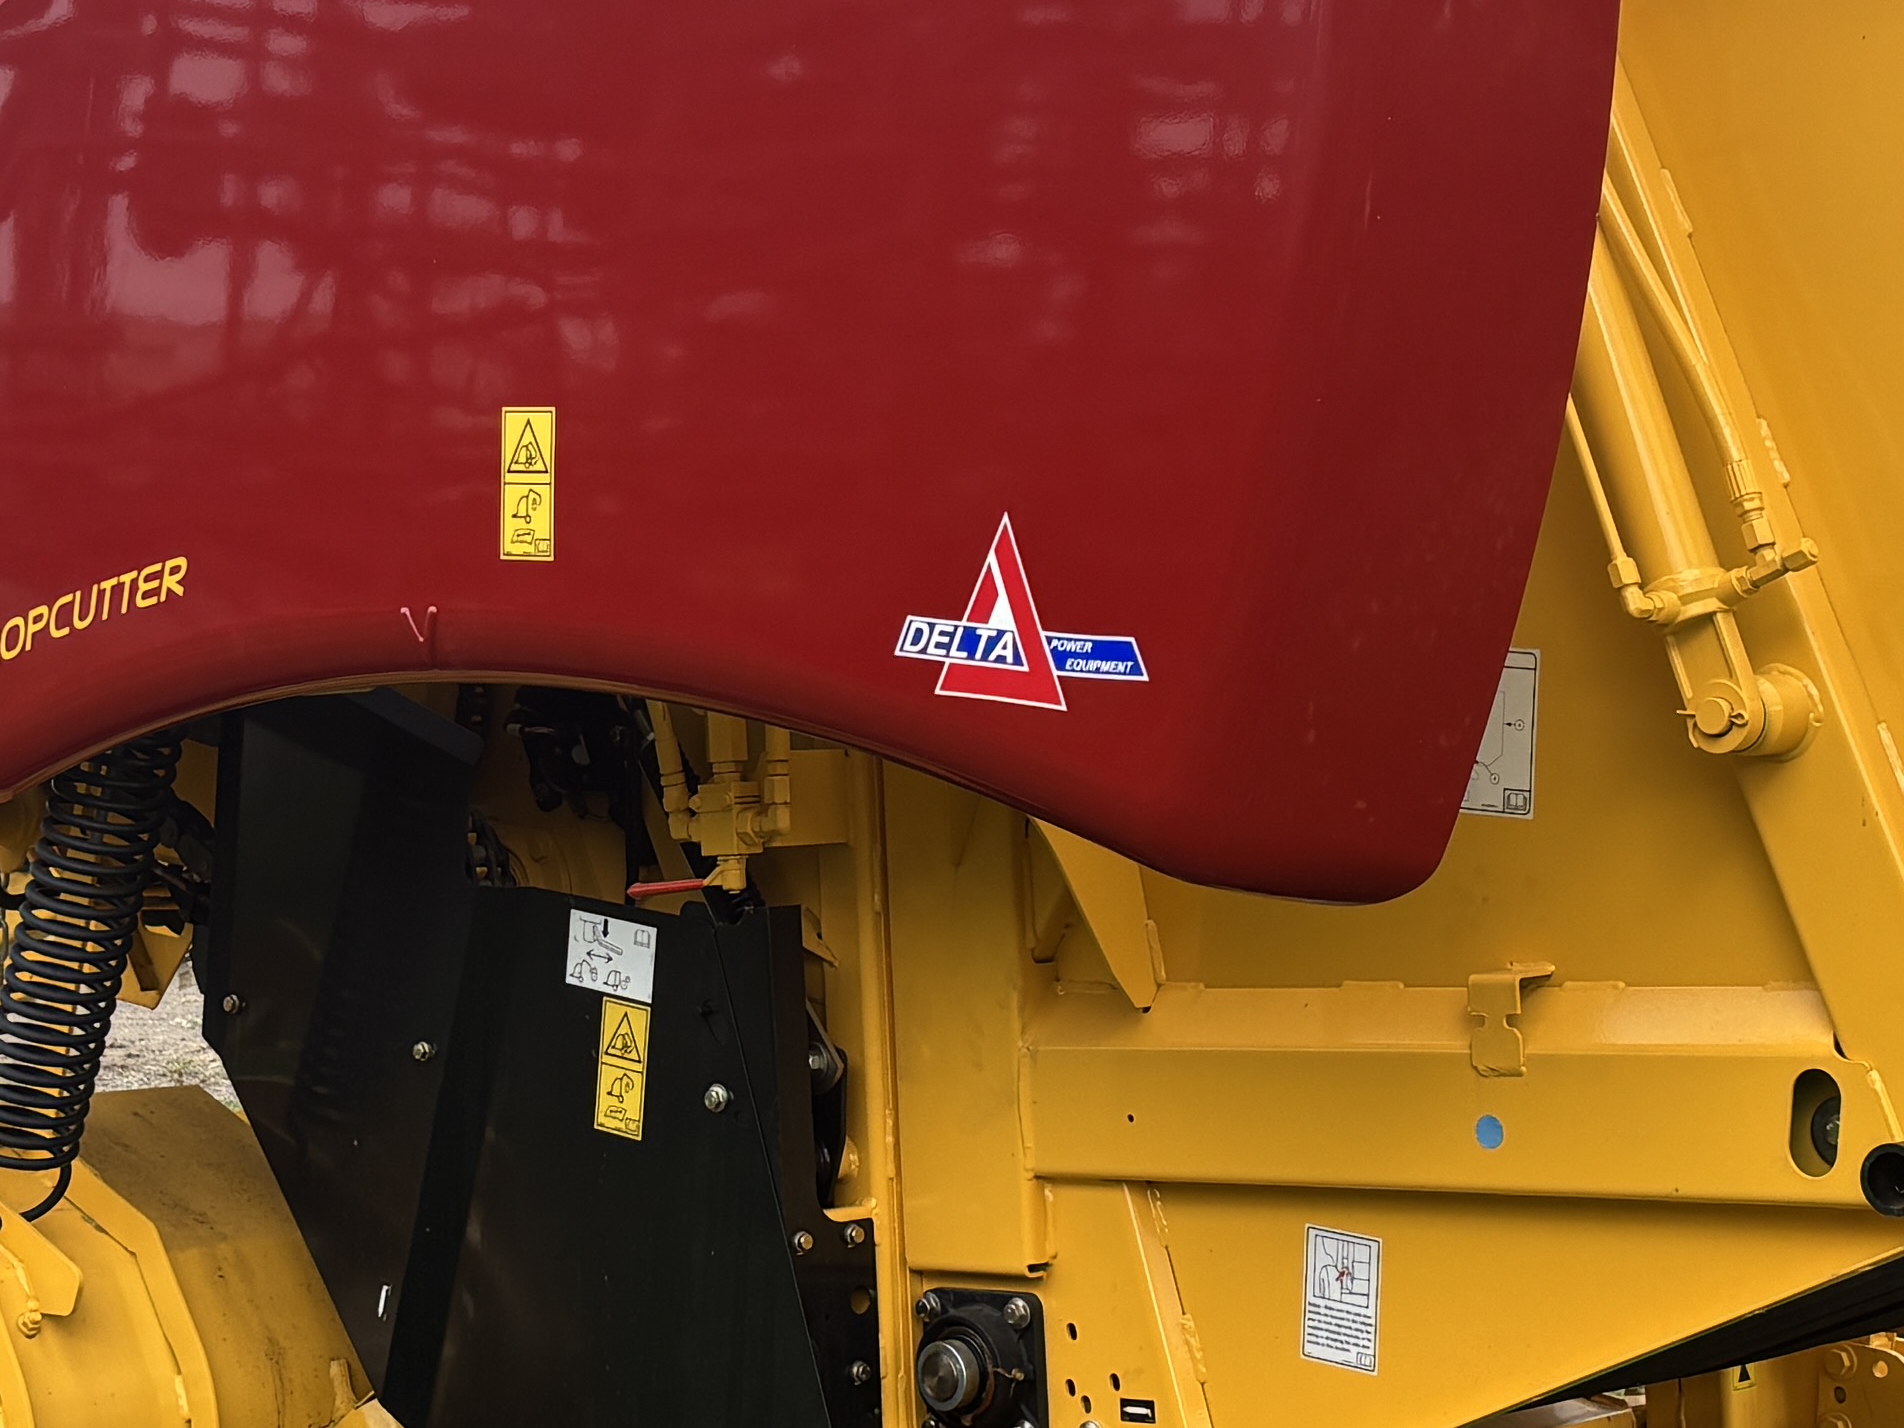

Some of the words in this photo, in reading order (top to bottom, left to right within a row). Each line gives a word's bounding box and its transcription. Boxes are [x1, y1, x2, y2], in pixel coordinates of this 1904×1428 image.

[902, 620, 1014, 664] DELTA
[1049, 638, 1093, 654] POWER
[1065, 657, 1135, 675] EQUIPMENT
